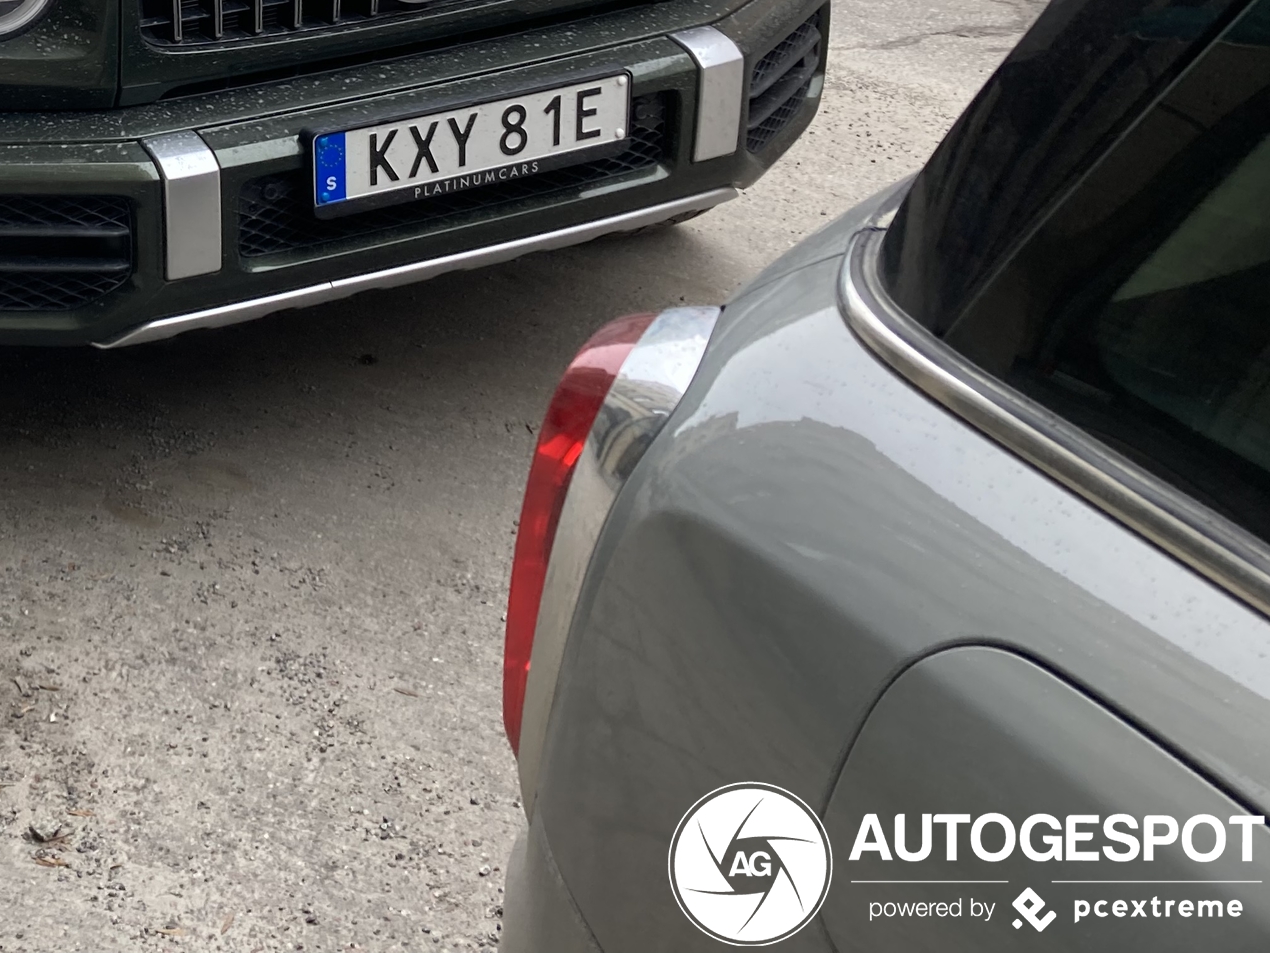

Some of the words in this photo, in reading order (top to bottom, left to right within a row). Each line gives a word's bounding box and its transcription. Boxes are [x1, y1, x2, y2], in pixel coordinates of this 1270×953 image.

[326, 176, 337, 191] S
[369, 113, 478, 186] KXY
[499, 86, 602, 156] 81E
[414, 161, 540, 199] PLATINUMCARS
